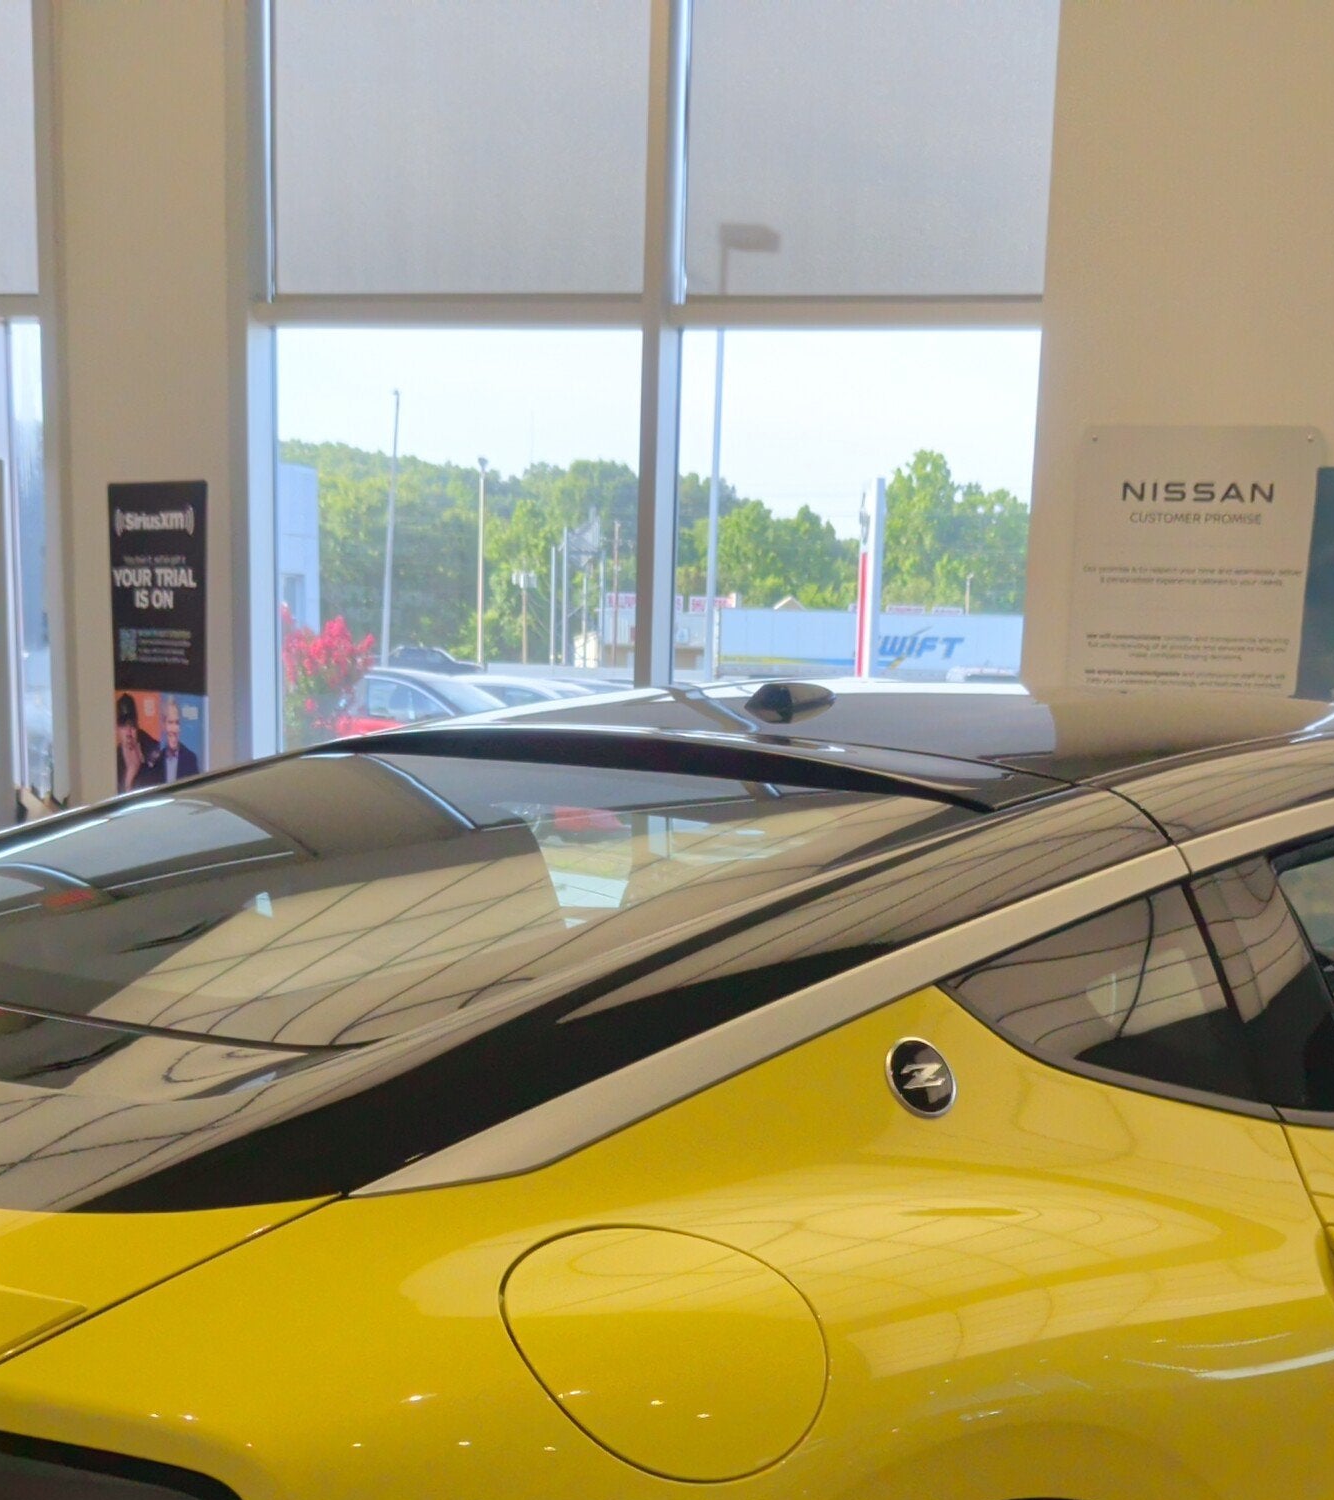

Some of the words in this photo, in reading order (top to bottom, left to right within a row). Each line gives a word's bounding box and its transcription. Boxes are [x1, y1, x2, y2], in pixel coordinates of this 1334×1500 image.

[1122, 482, 1274, 503] NISSAN
[1129, 511, 1201, 525] CUSTOMER
[1204, 513, 1262, 526] PROMISE
[113, 567, 152, 588] YOUR
[154, 566, 197, 588] TRIAL
[135, 589, 149, 609] IS
[151, 588, 174, 609] ON
[878, 635, 965, 659] WIFT
[900, 1062, 946, 1090] Z
